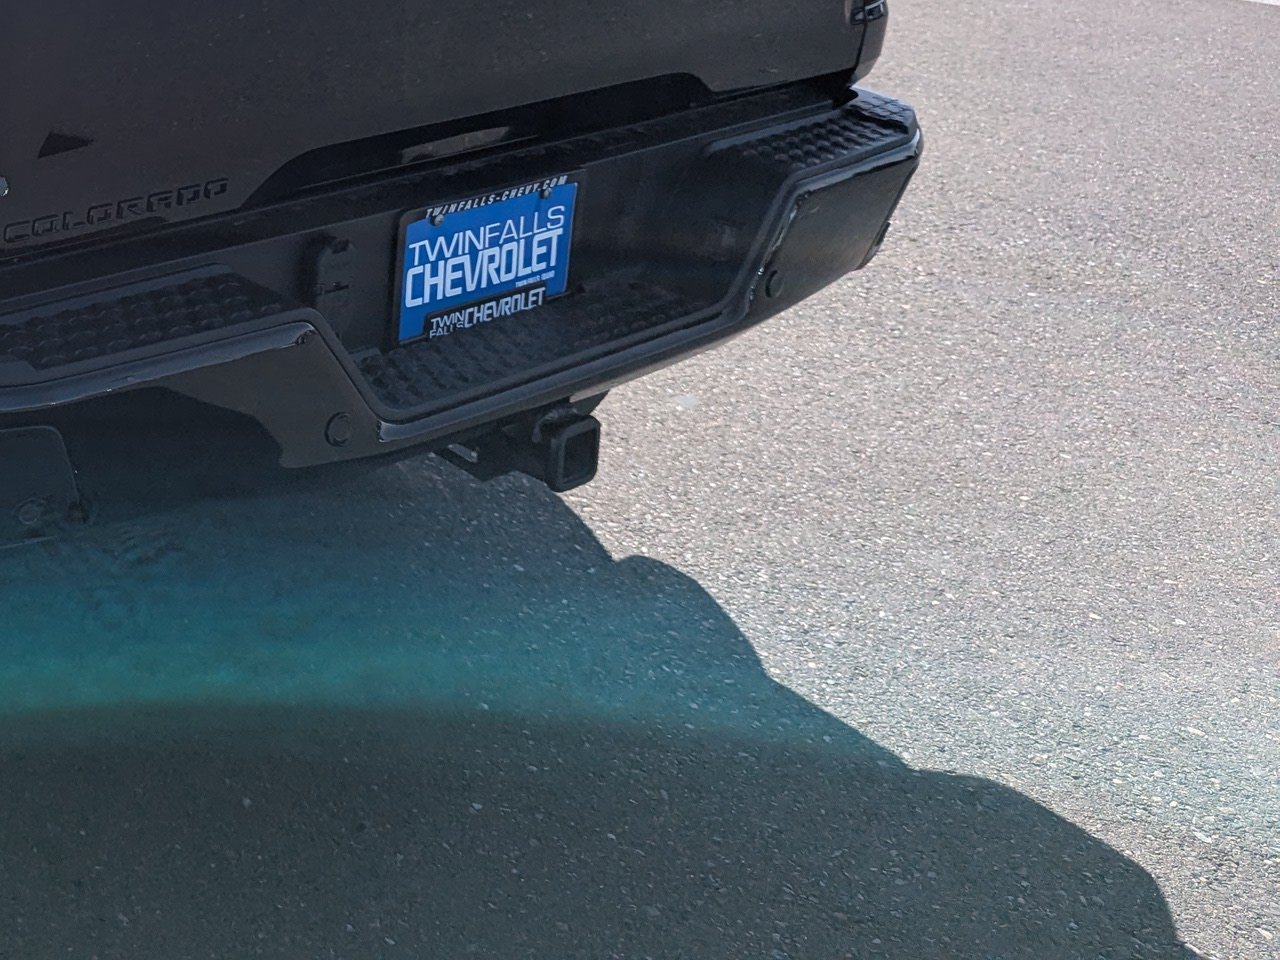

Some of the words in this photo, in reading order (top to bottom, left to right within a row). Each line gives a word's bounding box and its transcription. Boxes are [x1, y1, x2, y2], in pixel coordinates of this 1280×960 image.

[3, 178, 229, 244] COLORADO
[405, 228, 563, 308] CHEVROLET
[431, 310, 465, 331] TWIN
[464, 287, 546, 329] CHEVROLET
